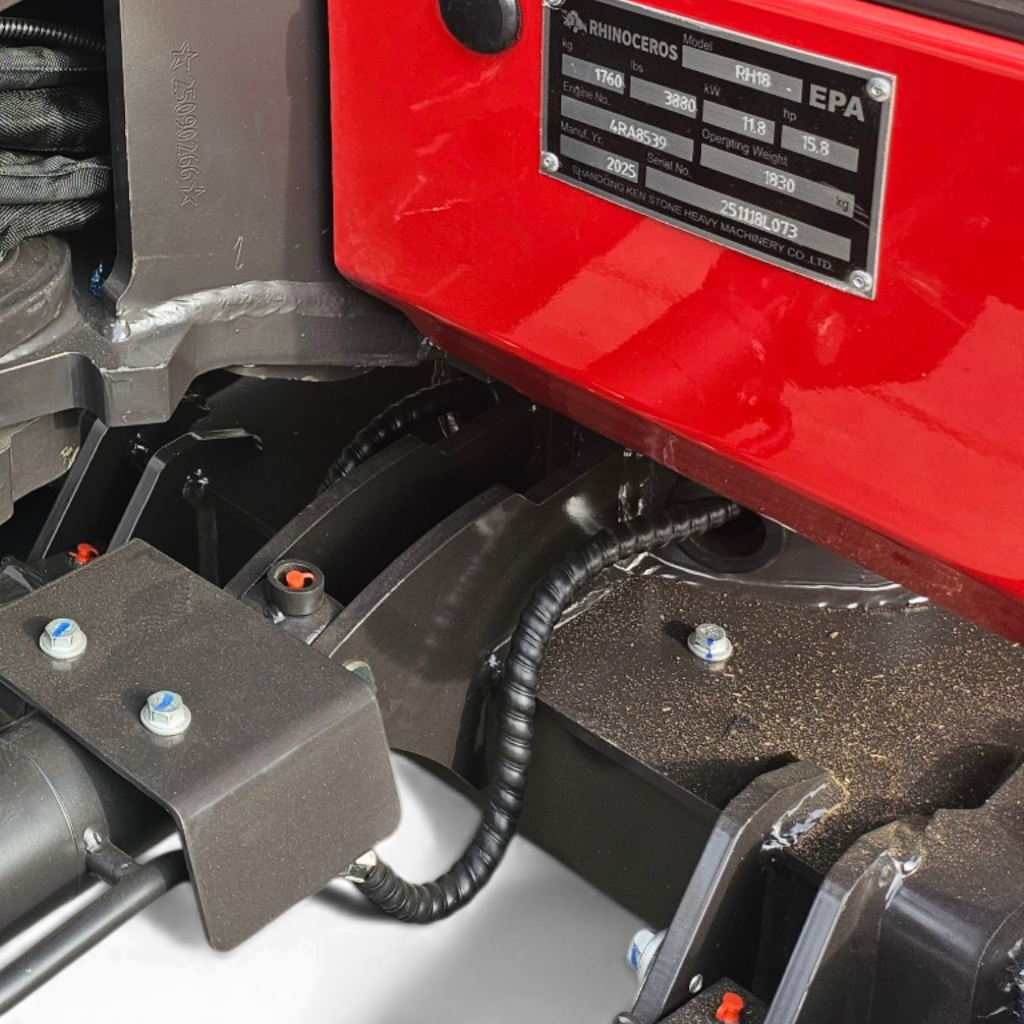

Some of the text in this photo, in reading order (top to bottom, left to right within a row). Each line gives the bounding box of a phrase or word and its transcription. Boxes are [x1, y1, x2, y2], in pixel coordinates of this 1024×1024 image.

[562, 38, 573, 52] kg
[589, 19, 679, 61] RHINOCEROS
[683, 33, 714, 52] Model
[594, 67, 623, 89] 1760
[630, 59, 644, 74] lbs
[734, 64, 772, 88] RH18
[562, 80, 611, 106] Engine No.
[663, 90, 696, 113] 3880
[703, 83, 721, 97] kW
[782, 107, 797, 122] hp
[808, 83, 865, 123] EPA
[173, 78, 199, 180] 25090266
[608, 119, 668, 150] 4RA8539
[741, 115, 767, 136] 11.8
[701, 127, 790, 168] Operating Weight
[801, 134, 831, 157] 15.8
[606, 156, 637, 178] 2025
[647, 152, 674, 171] Serial
[763, 169, 796, 193] 1830
[571, 165, 625, 193] SHANDONG
[626, 186, 648, 202] KEN
[648, 195, 683, 216] STONE
[684, 206, 718, 228] HEAVY
[720, 221, 785, 253] MACHINERY
[835, 195, 850, 213] kg
[719, 199, 799, 239] 251118L073
